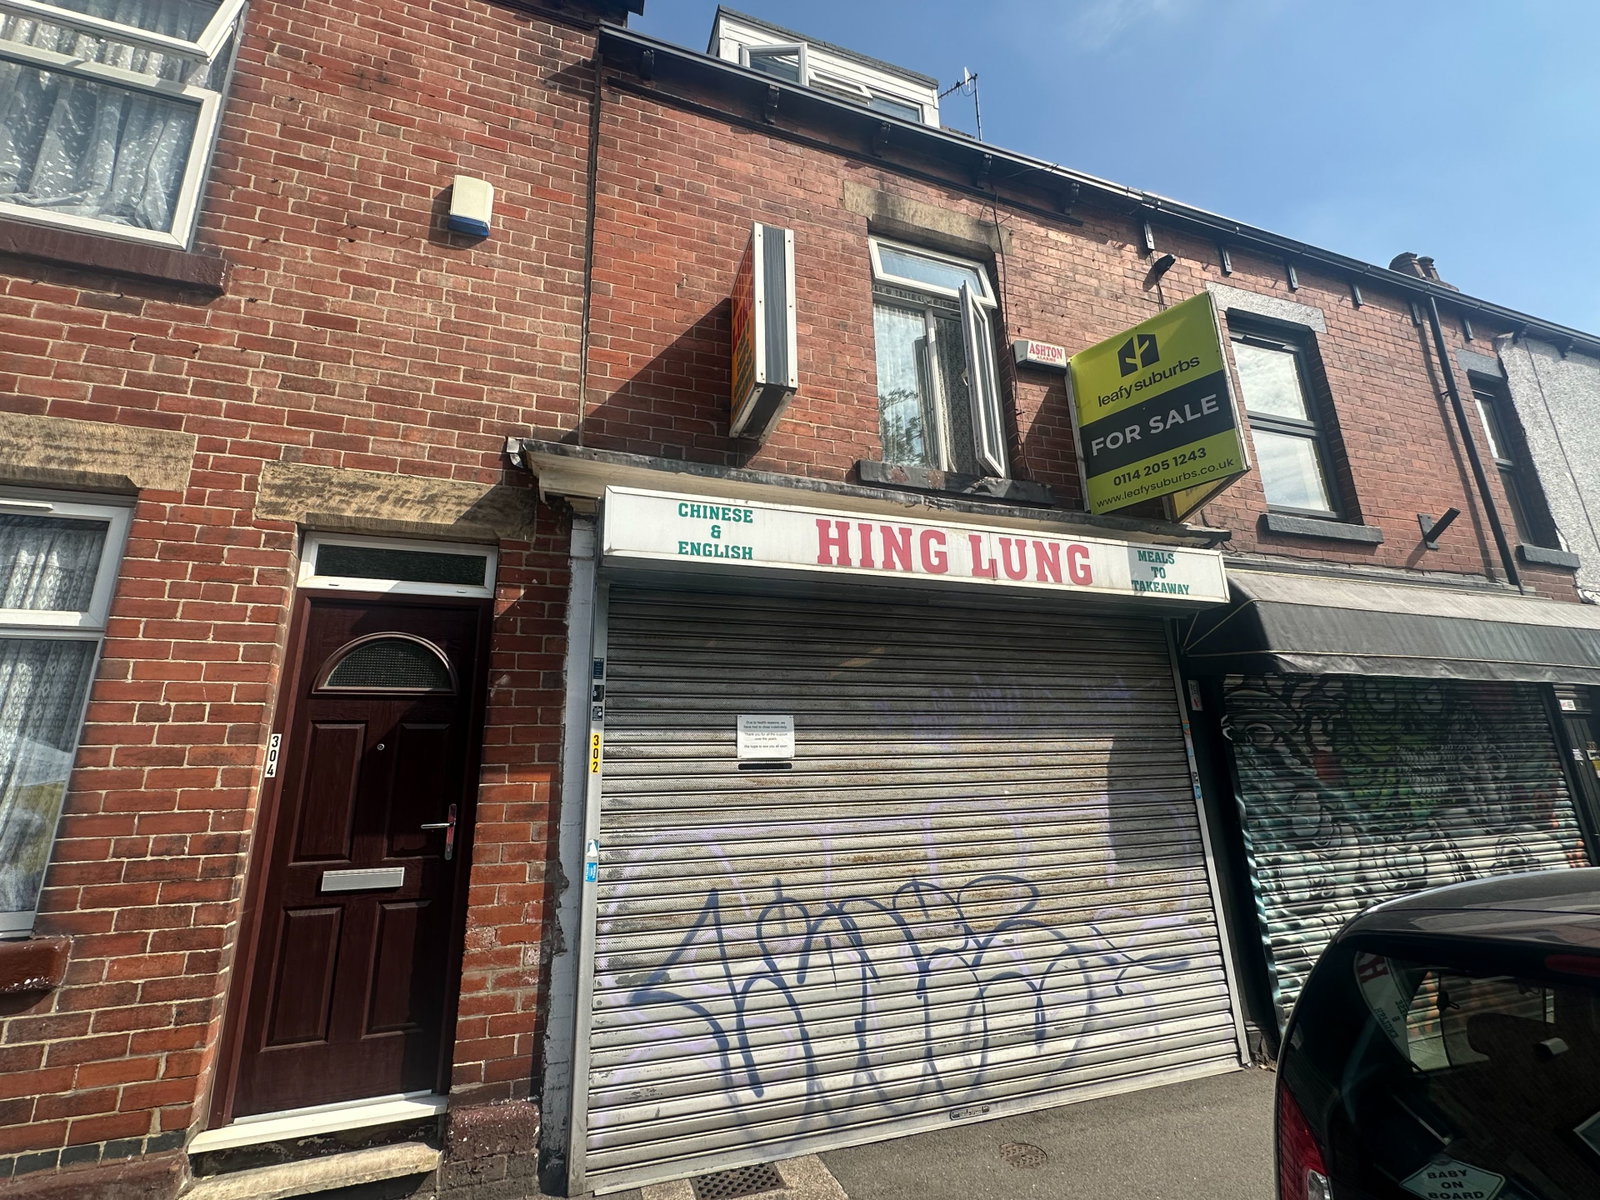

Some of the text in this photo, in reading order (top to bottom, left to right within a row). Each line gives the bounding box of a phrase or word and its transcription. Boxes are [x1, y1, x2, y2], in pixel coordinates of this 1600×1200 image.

[1029, 342, 1063, 360] ASHTON
[1091, 393, 1220, 457] FOR SALE
[1113, 447, 1207, 487] 0114 205 1243
[1096, 458, 1235, 508] www.leafysuburbs.co.uk
[677, 502, 754, 524] CHINESE
[710, 525, 722, 539] &
[677, 539, 754, 561] ENGLISH
[815, 518, 1093, 586] HING LUNG
[1137, 549, 1176, 566] MEALS
[1151, 565, 1167, 579] TO
[1131, 579, 1191, 596] TAKEAWAY
[266, 735, 279, 776] 304
[592, 734, 600, 773] 302
[1427, 1168, 1467, 1179] BABY
[1441, 1180, 1465, 1189] ON
[1427, 1190, 1485, 1200] BOARD
